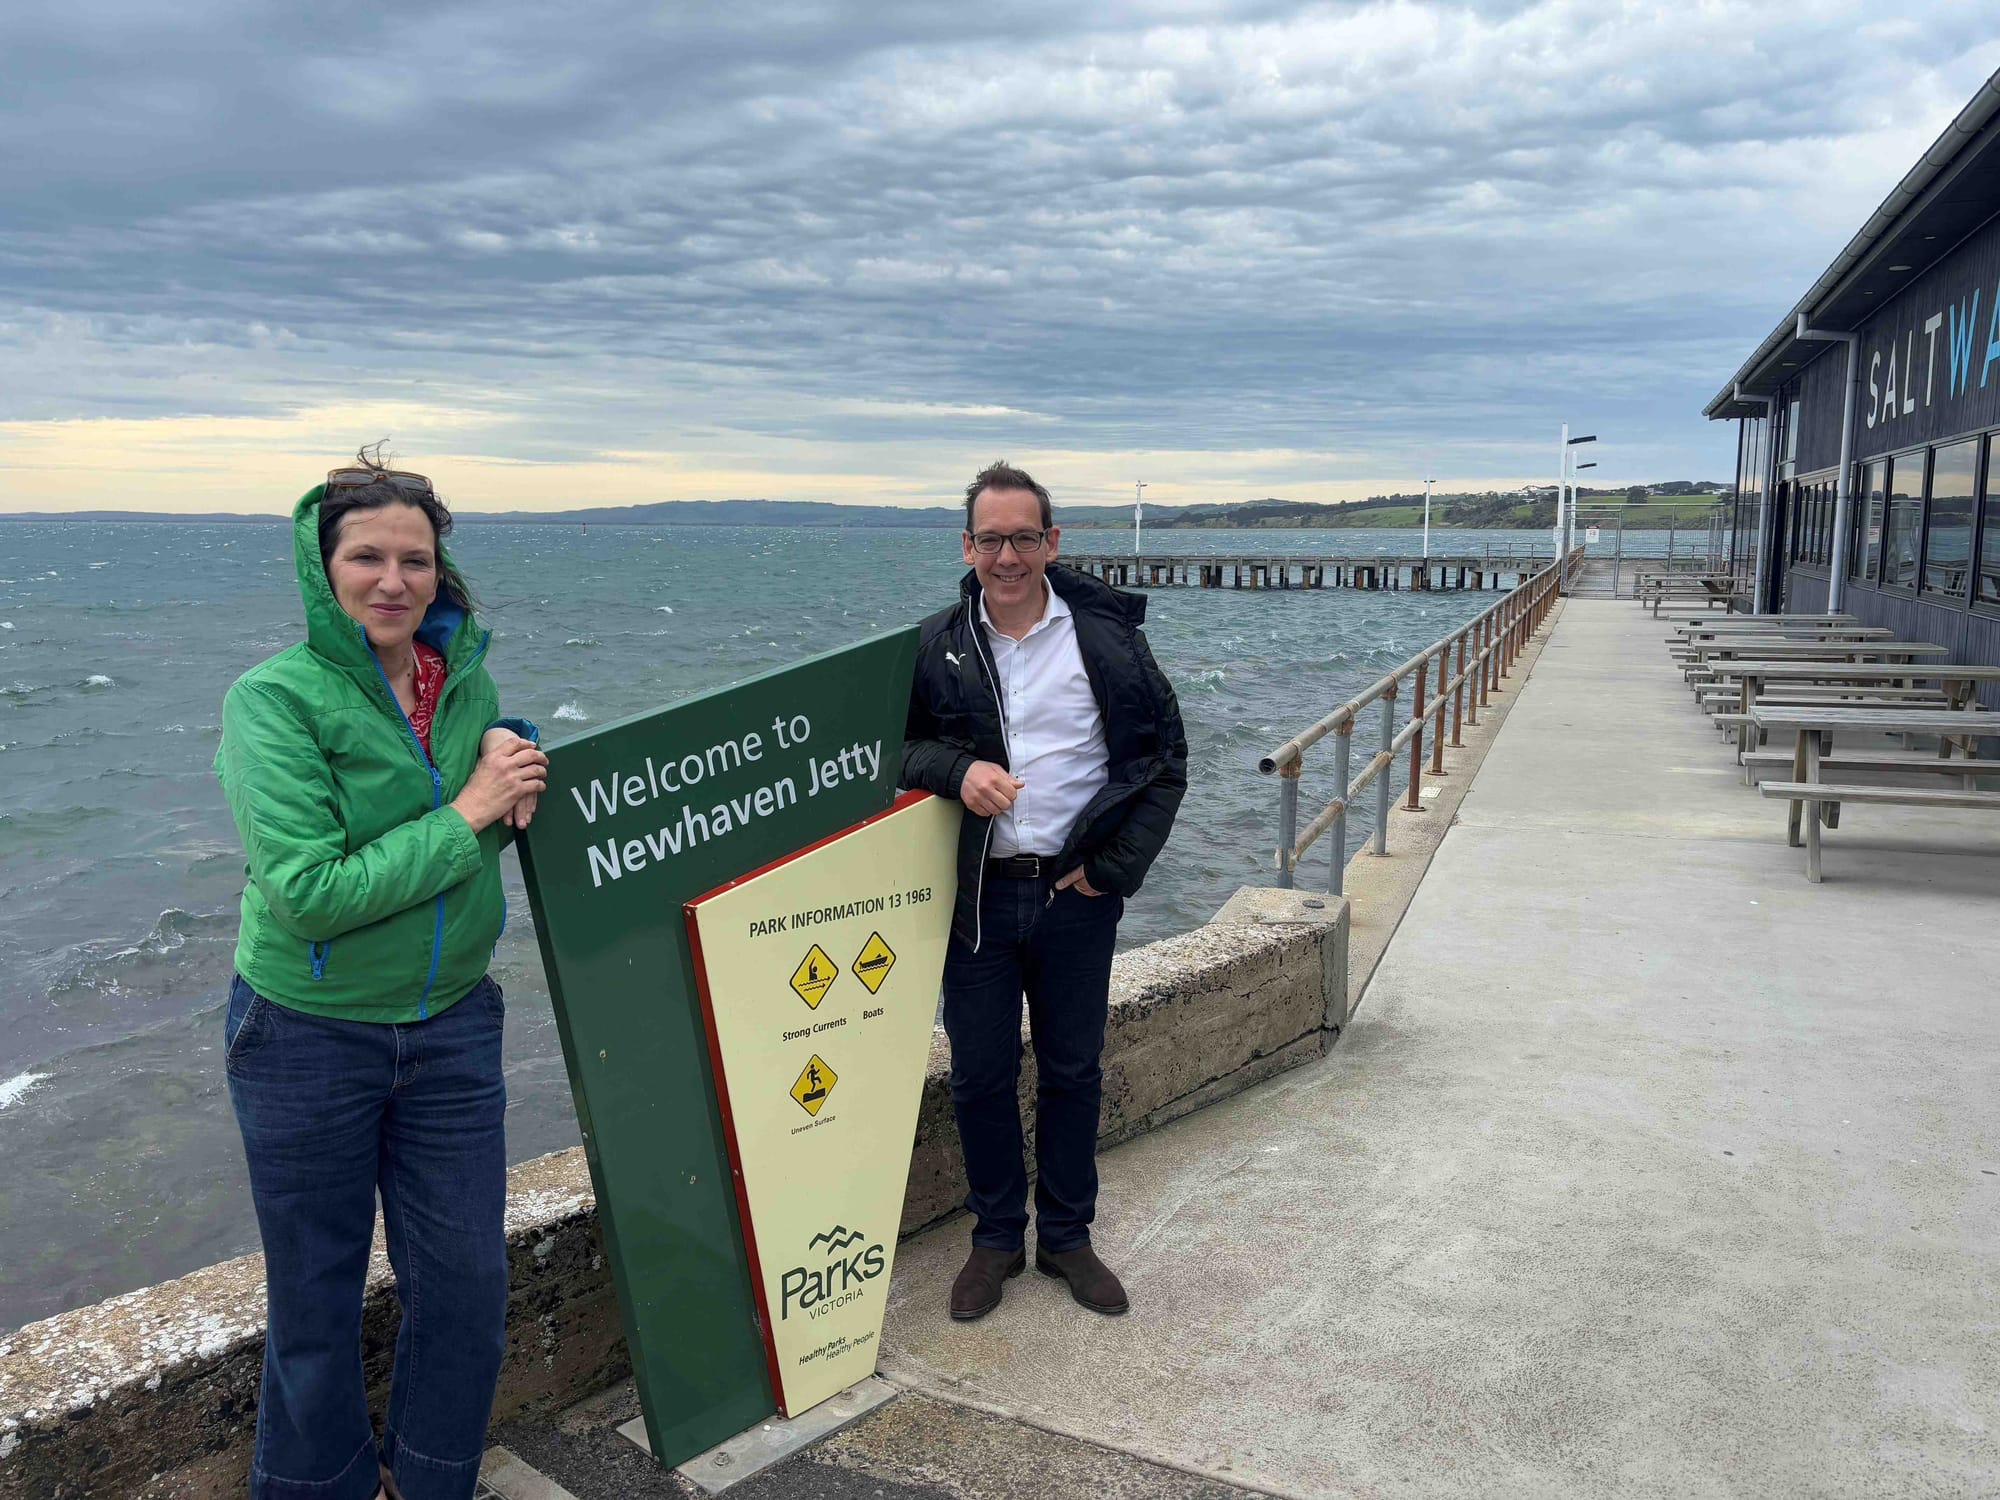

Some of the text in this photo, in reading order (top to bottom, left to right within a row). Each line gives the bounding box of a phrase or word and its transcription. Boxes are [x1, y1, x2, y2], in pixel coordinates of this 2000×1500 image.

[571, 714, 811, 824] Welcome to
[587, 739, 882, 888] Newhaven Jetty
[750, 887, 932, 938] PARK INFORMATION 13 1963
[782, 1017, 847, 1042] Strong Currents
[863, 1007, 884, 1020] Boats
[791, 1115, 836, 1135] Uneven Surface
[781, 1243, 885, 1321] Parks
[809, 1287, 864, 1320] VICTORIA
[798, 1336, 846, 1366] Healthy Parks
[826, 1330, 875, 1361] Healthy People
